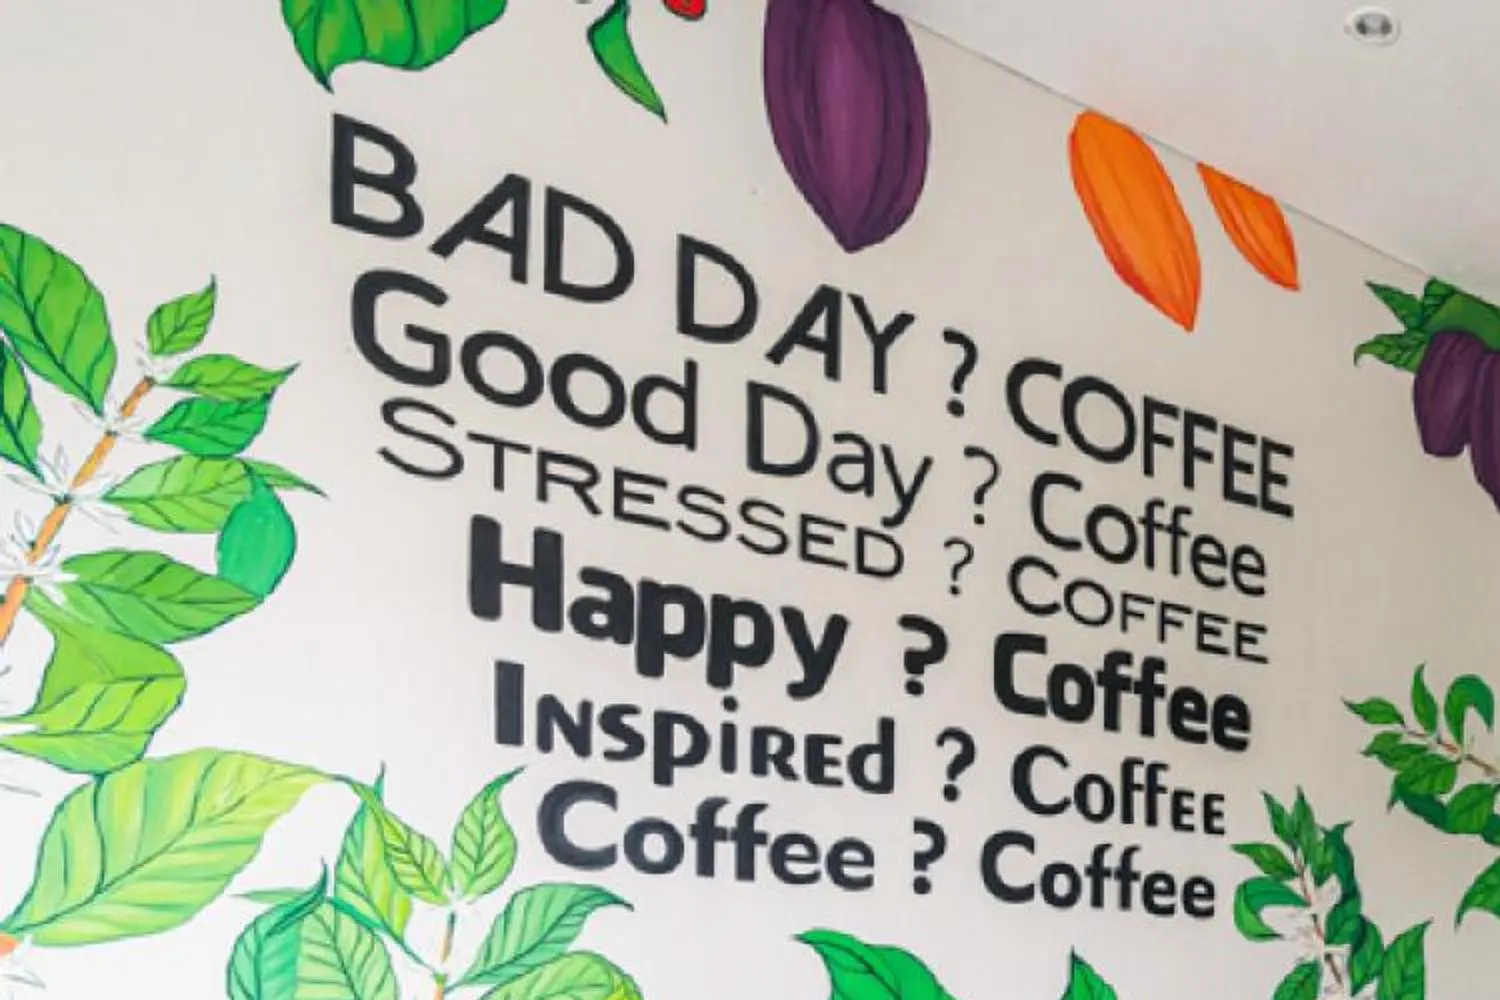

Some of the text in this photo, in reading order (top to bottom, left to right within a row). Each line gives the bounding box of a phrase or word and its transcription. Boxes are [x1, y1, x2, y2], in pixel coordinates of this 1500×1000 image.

[330, 112, 636, 305] BAD
[675, 232, 917, 396] DAY
[1004, 356, 1296, 520] COFFEE
[351, 268, 699, 453] Good
[745, 379, 934, 530] Day
[1029, 470, 1268, 599] Coffee
[377, 396, 906, 580] STRESSED
[1006, 554, 1270, 666] COFFEE
[467, 513, 851, 702] Happy
[992, 631, 1253, 754] Coffee
[537, 778, 876, 892] Coffee
[979, 829, 1217, 921] Coffee
